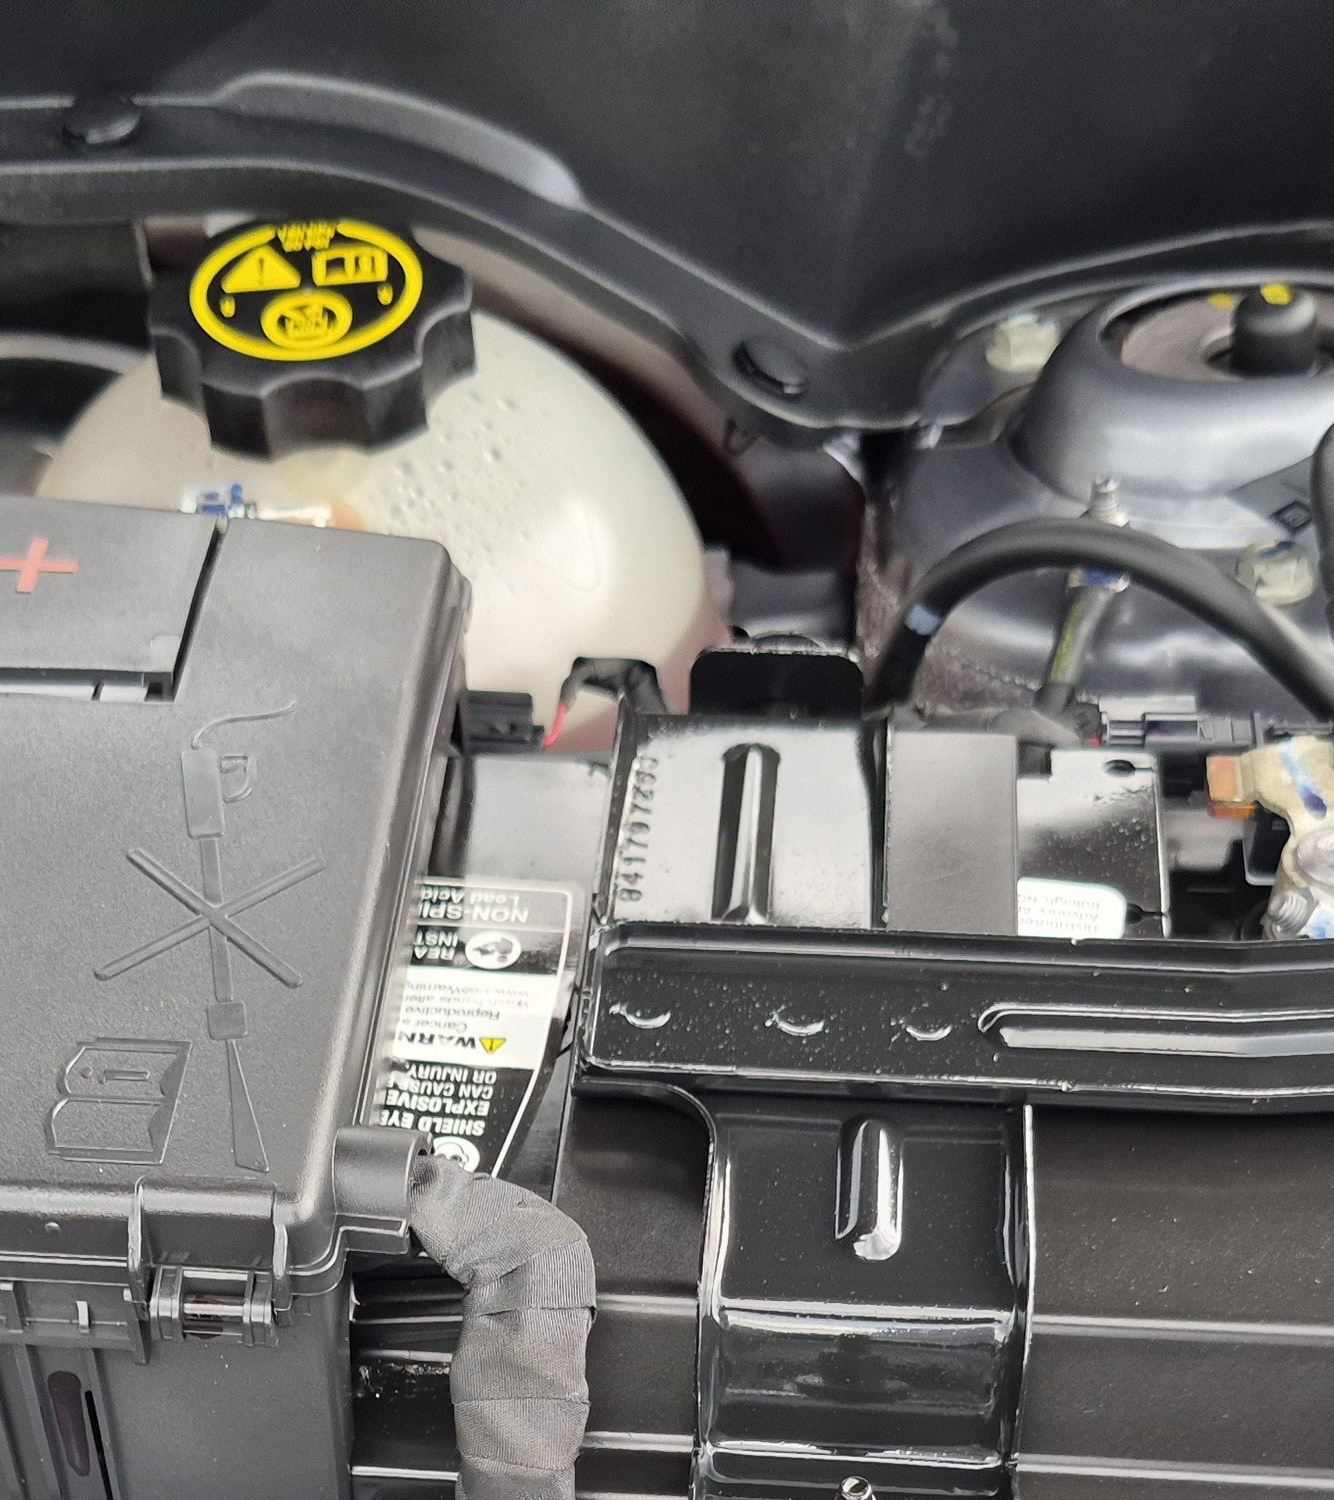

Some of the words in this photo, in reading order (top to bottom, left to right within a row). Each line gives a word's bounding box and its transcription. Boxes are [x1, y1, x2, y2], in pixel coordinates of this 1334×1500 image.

[420, 886, 465, 903] Acid
[470, 891, 519, 906] Lead
[413, 931, 458, 947] INST
[414, 946, 455, 960] REA
[405, 1006, 500, 1021] Reproductive
[415, 1020, 467, 1034] Cancer
[397, 1031, 476, 1050] WARN
[405, 1061, 468, 1083] INJURY.
[473, 1070, 497, 1085] OR
[459, 1083, 493, 1100] CAN
[385, 1089, 490, 1117] EXPLOSIVE
[417, 1116, 485, 1136] SHIELD
